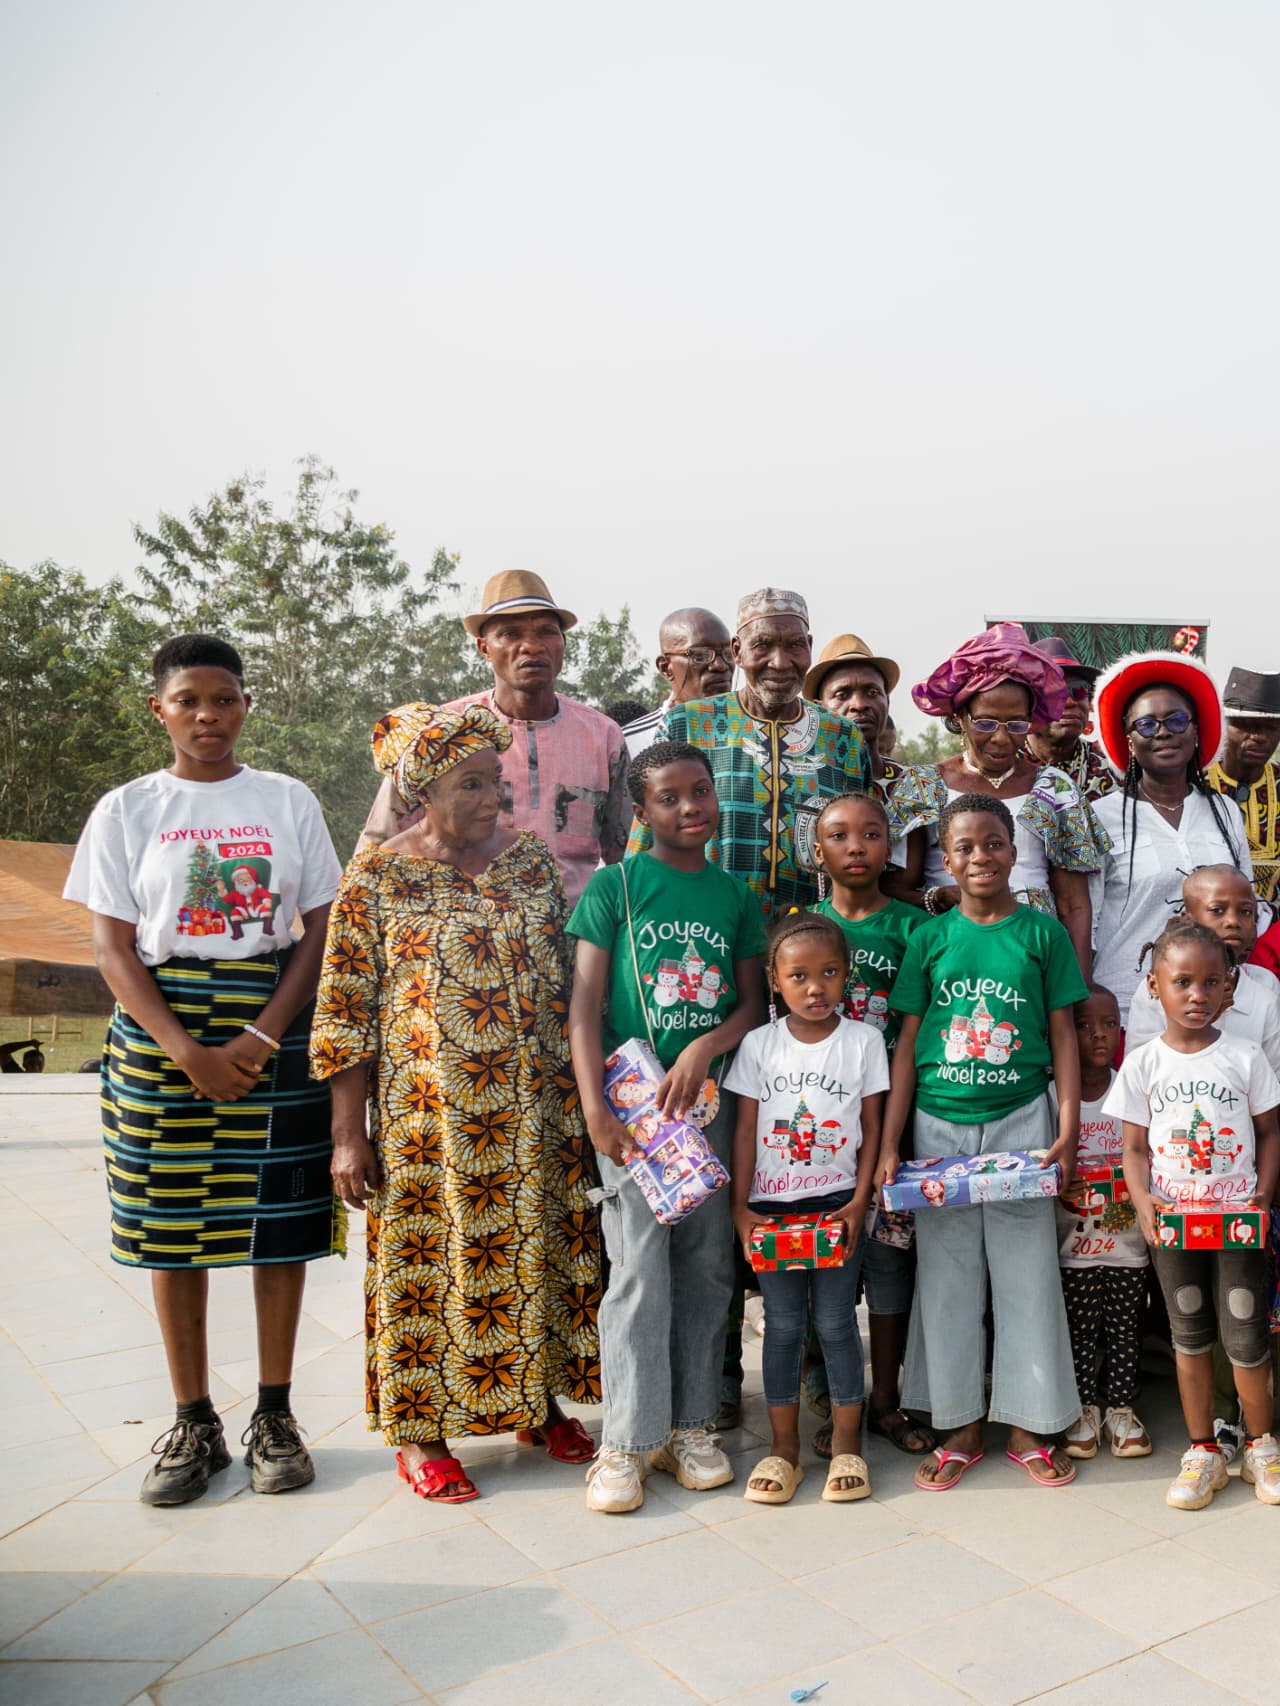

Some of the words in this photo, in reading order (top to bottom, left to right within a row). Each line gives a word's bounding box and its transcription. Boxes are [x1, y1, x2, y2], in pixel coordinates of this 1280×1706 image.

[160, 828, 225, 844] JOYEUX
[229, 824, 274, 838] NOËL
[226, 844, 266, 857] 2024
[640, 920, 730, 957] Joyeux
[937, 978, 1027, 1012] Joyeux
[647, 1005, 687, 1030] Noël
[936, 1060, 974, 1085] Noël
[977, 1068, 1021, 1085] 2024
[760, 1072, 851, 1103] Joyeux
[1153, 1080, 1239, 1113] Joyeux
[755, 1171, 790, 1195] Noël
[1154, 1174, 1196, 1202] Noël
[1199, 1177, 1249, 1201] 2024
[1071, 1235, 1116, 1255] 2024
